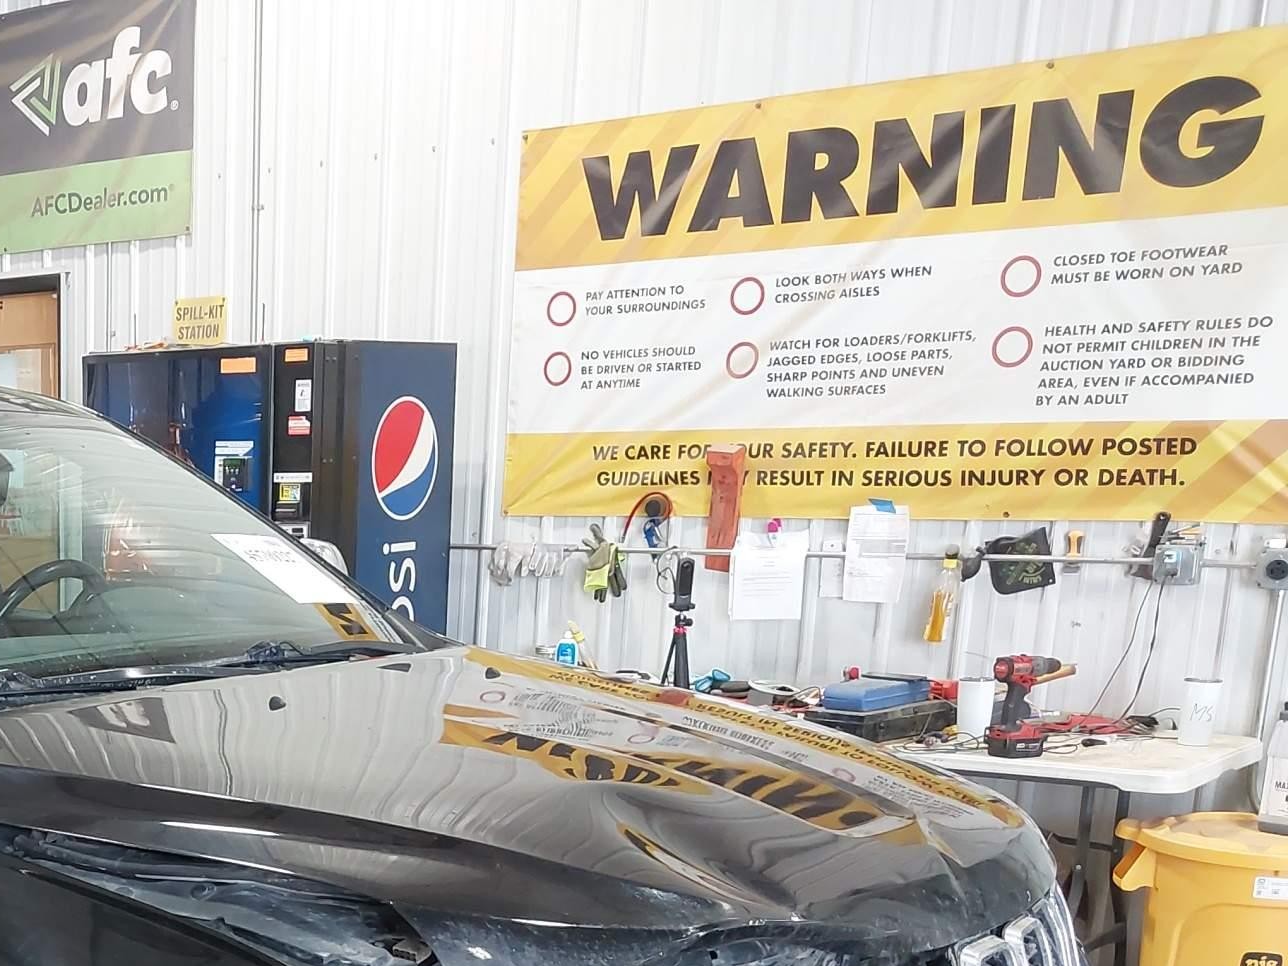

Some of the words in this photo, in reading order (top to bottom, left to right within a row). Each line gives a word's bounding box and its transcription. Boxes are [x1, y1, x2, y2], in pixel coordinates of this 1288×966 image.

[582, 75, 1265, 241] WARNING
[30, 184, 168, 219] AFCDealer.com
[1054, 253, 1105, 267] CLOSED
[1110, 251, 1136, 264] TOE
[1140, 245, 1228, 261] FOOTWEAR
[775, 275, 810, 288] LOOK
[814, 271, 846, 285] BOTH
[850, 269, 886, 282] WAYS
[890, 265, 932, 279] WHEN
[1051, 272, 1089, 285] MUST
[1094, 270, 1110, 282] BE
[1115, 268, 1164, 280] WORN
[1169, 265, 1195, 278] ON
[1201, 262, 1242, 276] YARD
[586, 291, 603, 301] PAY
[606, 287, 666, 299] ATTENTION
[670, 285, 684, 295] TO
[774, 289, 835, 304] CROSSING
[839, 286, 880, 298] AISLES
[176, 305, 224, 321] SPILL-KIT
[585, 305, 613, 316] YOUR
[617, 299, 705, 314] SURROUNDINGS
[178, 324, 219, 340] STATION
[1045, 324, 1096, 337] HEALTH
[1101, 322, 1133, 334] AND
[1138, 320, 1192, 333] SAFETY
[1195, 318, 1243, 331] RULES
[1247, 316, 1273, 328] DO
[770, 339, 812, 351] WATCH
[815, 338, 840, 349] FOR
[843, 330, 977, 347] LOADERS/FORKLIFTS,
[1042, 343, 1072, 354] NOT
[1077, 340, 1126, 353] PERMIT
[1131, 338, 1203, 351] CHILDREN
[1208, 337, 1226, 348] IN
[1231, 336, 1260, 347] THE
[581, 349, 599, 360] NO
[602, 347, 649, 359] VEHICLES
[652, 346, 695, 357] SHOULD
[767, 354, 817, 367] JAGGED
[820, 353, 863, 367] EDGES,
[866, 350, 909, 363] LOOSE
[910, 348, 953, 361] PARTS,
[581, 364, 594, 375] BE
[597, 363, 634, 374] DRIVEN
[637, 362, 653, 372] OR
[656, 360, 701, 372] STARTED
[1040, 360, 1103, 372] AUCTION
[1108, 358, 1146, 369] YARD
[1151, 356, 1172, 368] OR
[1177, 354, 1245, 367] BIDDING
[767, 371, 807, 383] SHARP
[811, 369, 857, 381] POINTS
[860, 367, 887, 379] AND
[891, 365, 944, 379] UNEVEN
[1038, 377, 1078, 389] AREA,
[1083, 376, 1120, 388] EVEN
[1124, 375, 1136, 386] IF
[1141, 373, 1254, 386] ACCOMPANIED
[580, 379, 594, 389] AT
[596, 378, 640, 389] ANYTIME
[766, 386, 824, 398] WALKING
[828, 384, 886, 397] SURFACES
[1036, 395, 1053, 406] BY
[1057, 394, 1080, 405] AN
[1085, 394, 1128, 405] ADULT
[593, 446, 618, 460] WE
[625, 445, 670, 460] CARE
[781, 441, 857, 458] SAFETY.
[865, 440, 949, 458] FAILURE
[958, 439, 986, 458] TO
[995, 438, 1095, 457] FOLLOW
[1101, 437, 1197, 457] POSTED
[596, 470, 700, 487] GUIDELINES
[756, 470, 823, 486] RESULT
[831, 470, 853, 486] IN
[861, 469, 952, 487] SERIOUS
[961, 468, 1046, 486] INJURY
[1054, 468, 1089, 486] OR
[1098, 468, 1185, 486] DEATH.
